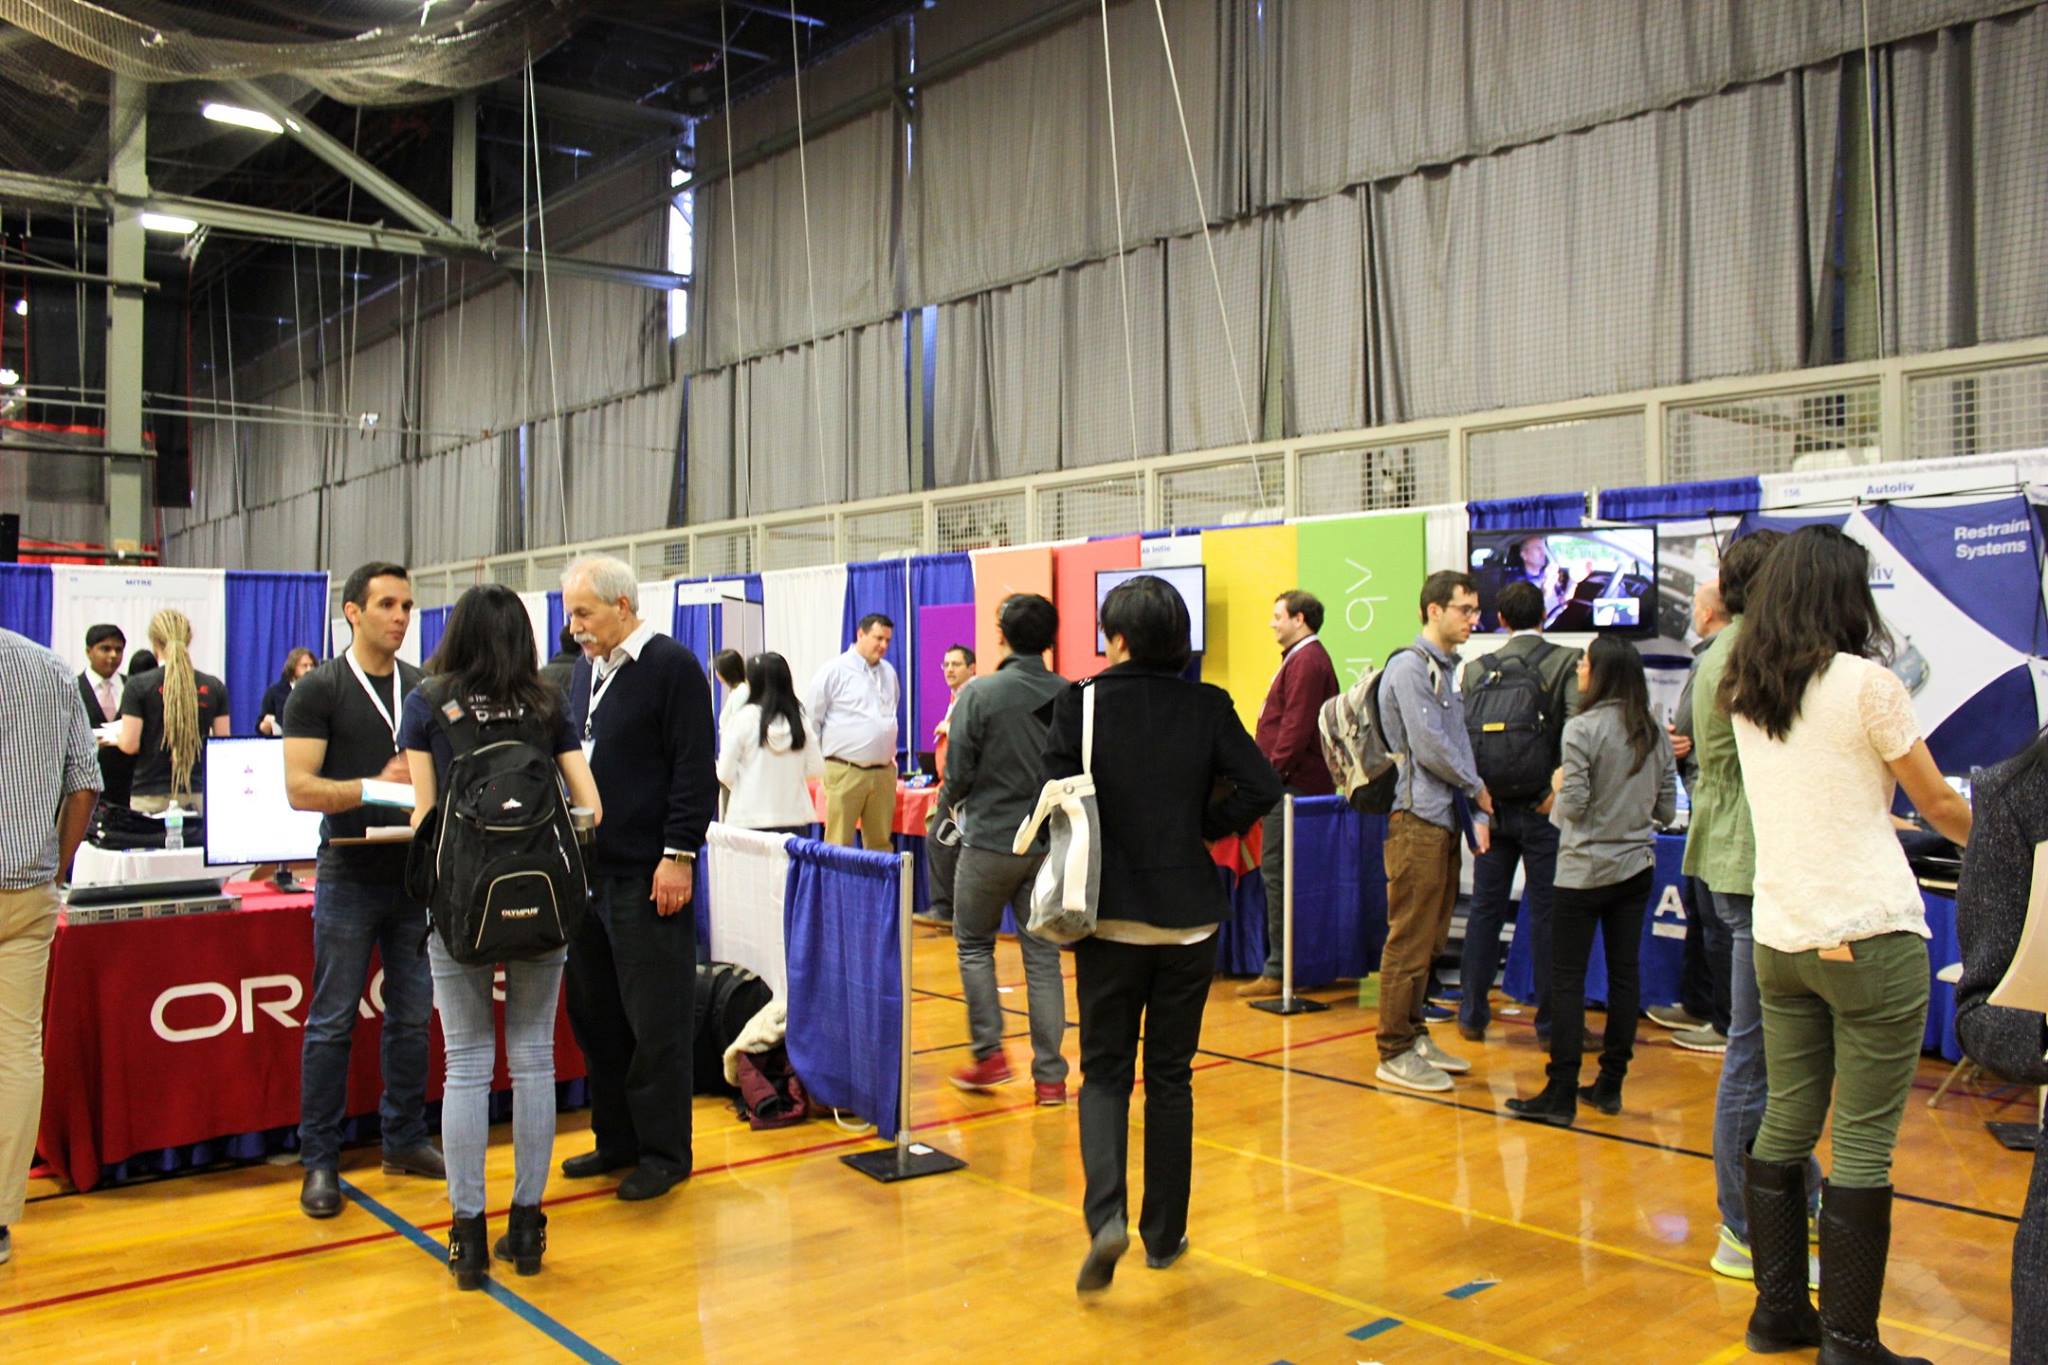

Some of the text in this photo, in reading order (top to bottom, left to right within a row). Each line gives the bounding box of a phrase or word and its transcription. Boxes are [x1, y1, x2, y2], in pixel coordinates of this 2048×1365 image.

[1866, 482, 1915, 495] Autoliv
[1955, 540, 2027, 560] Systems
[501, 907, 539, 918] OLYMPUS
